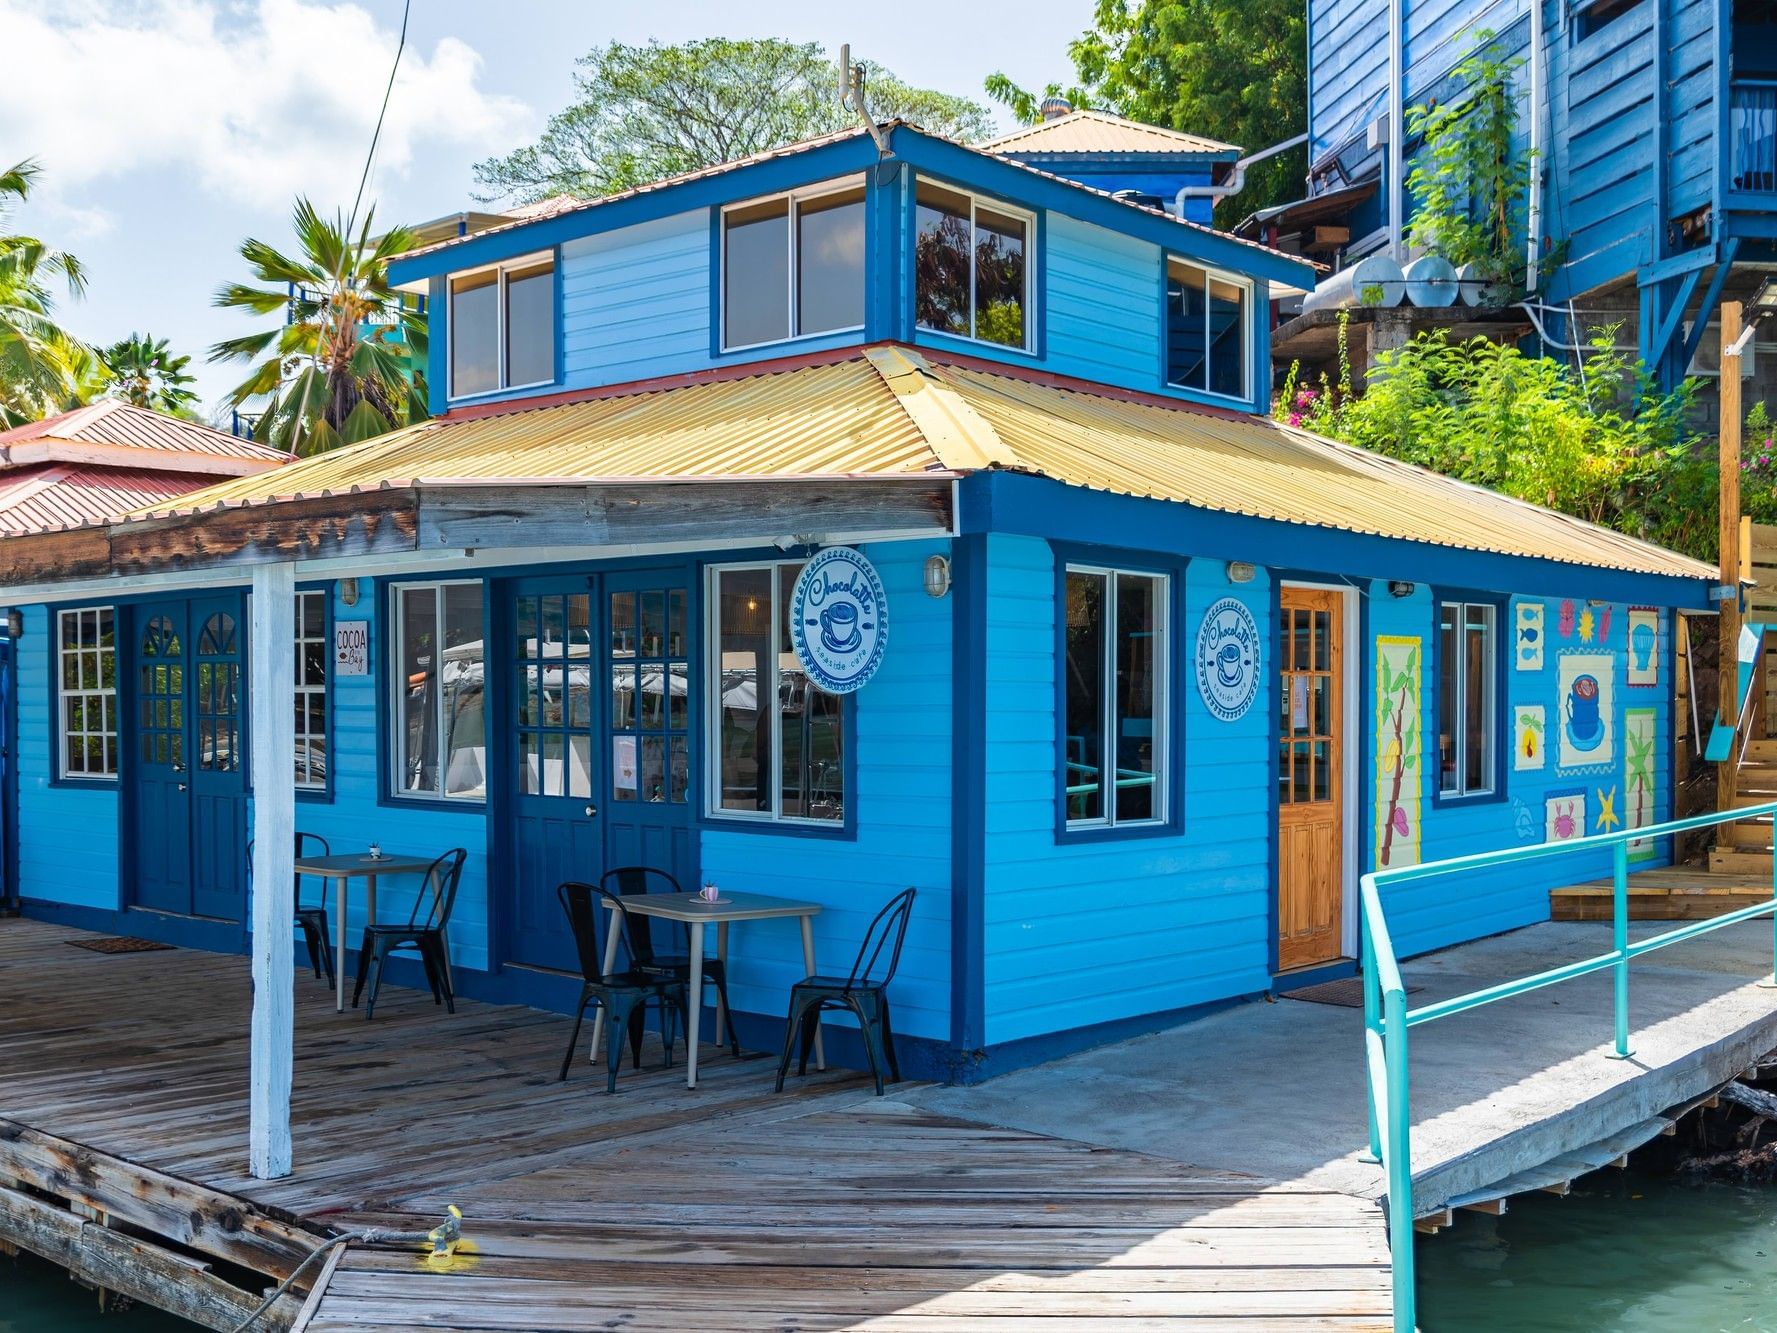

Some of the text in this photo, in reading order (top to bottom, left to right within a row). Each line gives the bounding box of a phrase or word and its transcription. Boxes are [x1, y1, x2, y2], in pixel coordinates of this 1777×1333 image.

[808, 570, 875, 615] Chocolatte
[337, 629, 367, 650] COCOA
[1208, 617, 1251, 653] Chocolatte
[348, 648, 364, 672] Bay
[814, 646, 847, 671] seaside
